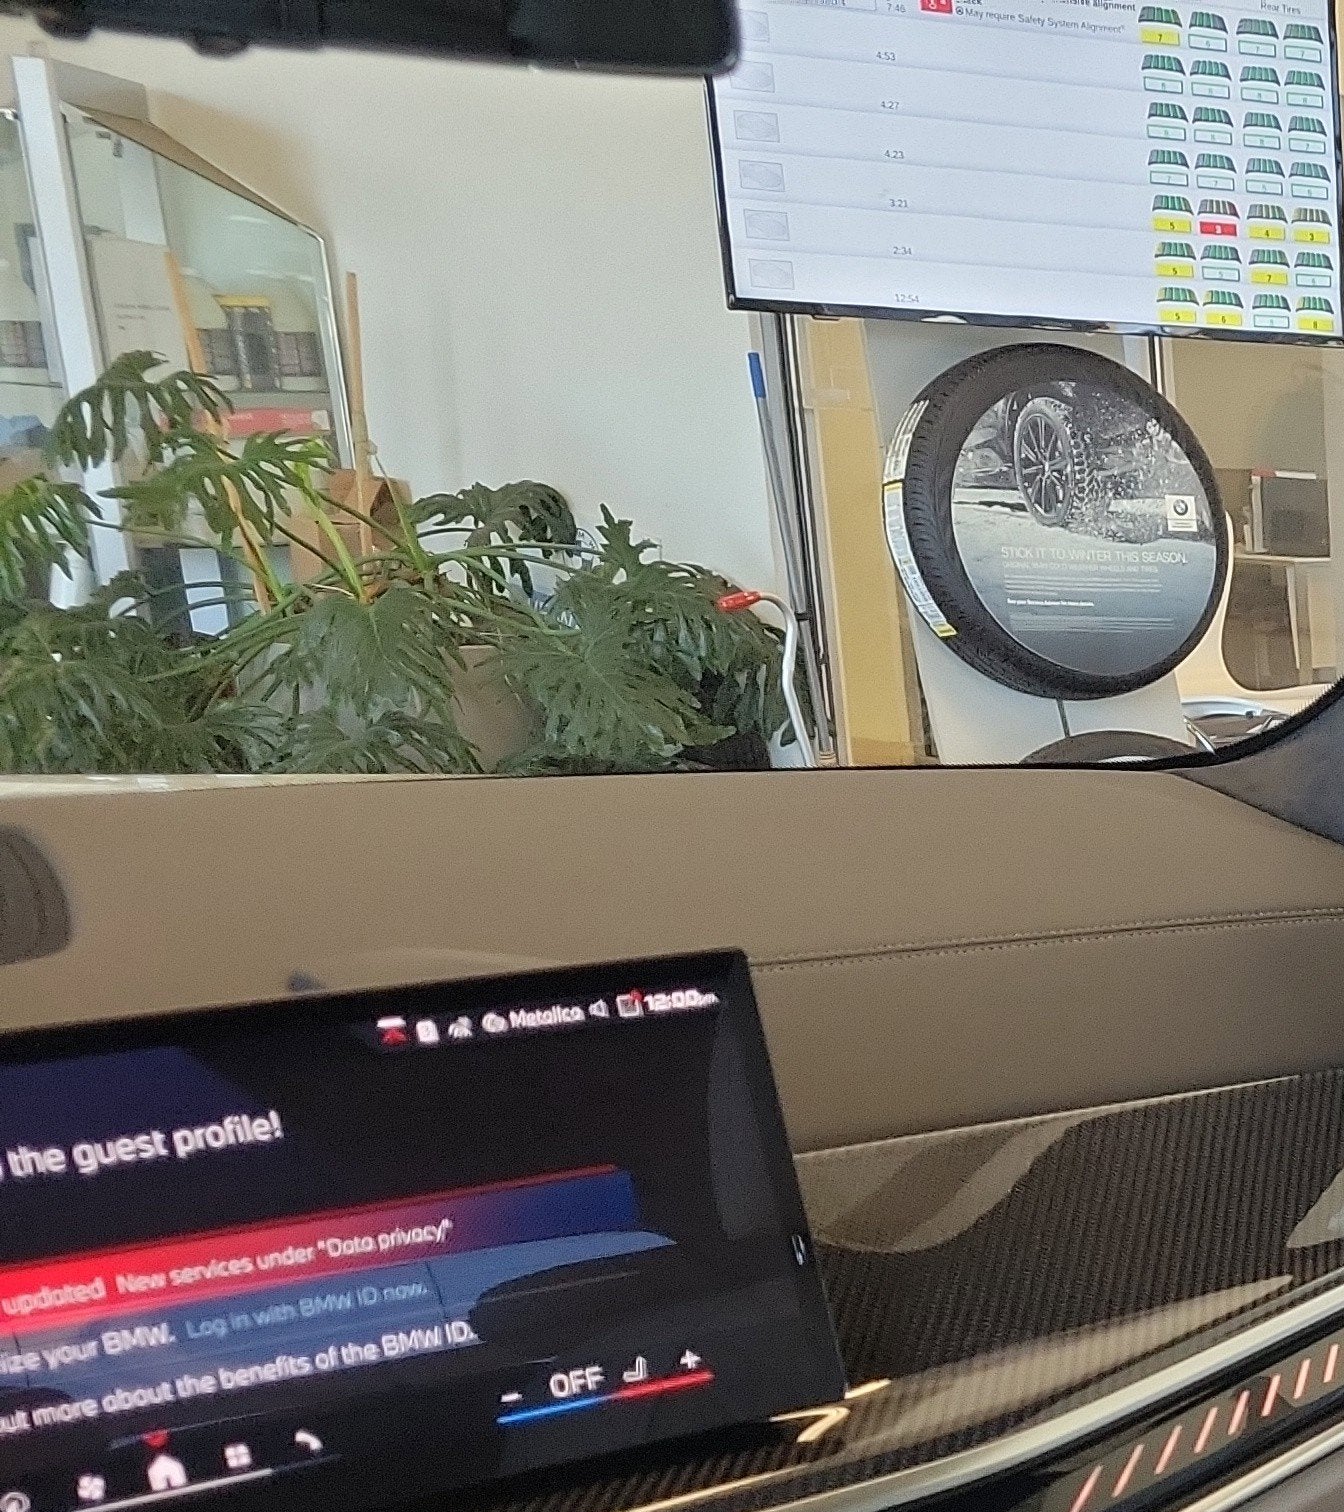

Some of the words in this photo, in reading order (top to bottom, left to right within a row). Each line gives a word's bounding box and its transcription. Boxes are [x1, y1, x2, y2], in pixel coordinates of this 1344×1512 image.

[965, 8, 983, 18] May
[1018, 14, 1045, 27] Safety
[1048, 17, 1079, 29] System
[1001, 546, 1033, 559] STICK
[1069, 548, 1112, 562] WINTER
[1115, 551, 1139, 563] THIS
[1142, 552, 1188, 565] SEASON.
[6, 1145, 67, 1177] the
[72, 1130, 169, 1175] guest
[172, 1110, 284, 1158] profile!
[3, 1277, 106, 1316] updated
[115, 1270, 166, 1295] New
[170, 1255, 253, 1287] services
[259, 1243, 316, 1272] under
[185, 1316, 228, 1340] Log
[231, 1310, 251, 1331] in
[254, 1301, 297, 1327] with
[299, 1292, 354, 1317] BMW
[356, 1284, 378, 1307] ID
[381, 1280, 430, 1302] now.
[34, 1399, 98, 1426] more
[102, 1379, 175, 1413] about
[177, 1370, 217, 1400] the
[218, 1354, 311, 1391] benefits
[314, 1343, 341, 1371] of
[343, 1338, 379, 1367] the
[380, 1327, 440, 1358] BMW
[442, 1318, 478, 1347] ID.
[45, 1338, 100, 1372] your
[102, 1322, 176, 1356] BMW.
[549, 1365, 605, 1398] OFF
